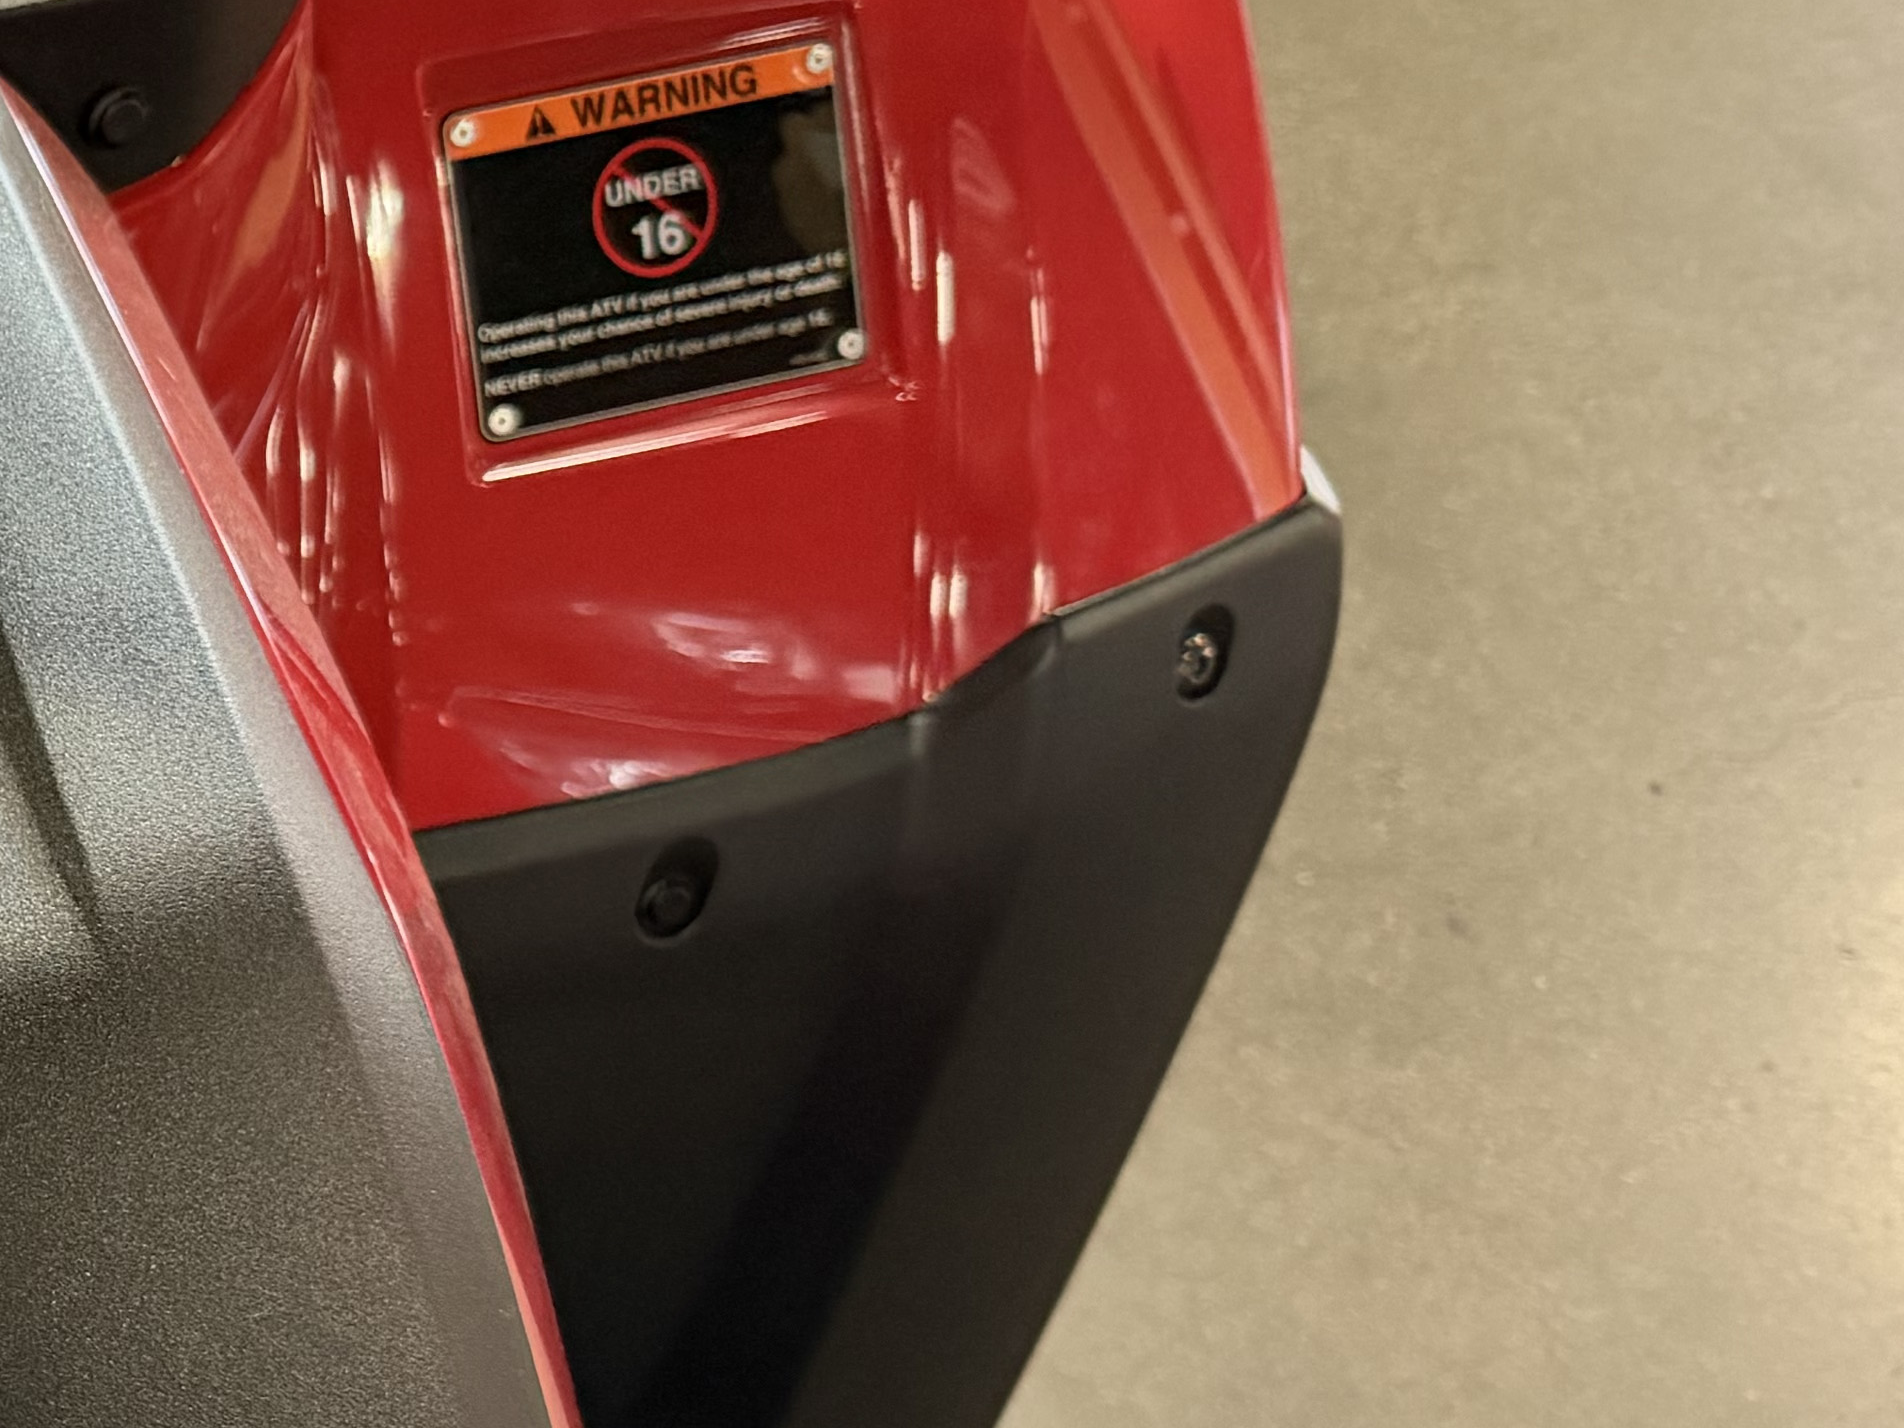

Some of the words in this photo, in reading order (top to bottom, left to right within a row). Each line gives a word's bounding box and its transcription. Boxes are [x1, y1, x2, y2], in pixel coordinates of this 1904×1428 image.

[570, 64, 758, 130] WARNING
[603, 161, 702, 208] UNDER
[631, 209, 687, 262] 16
[483, 368, 544, 399] NEVER
